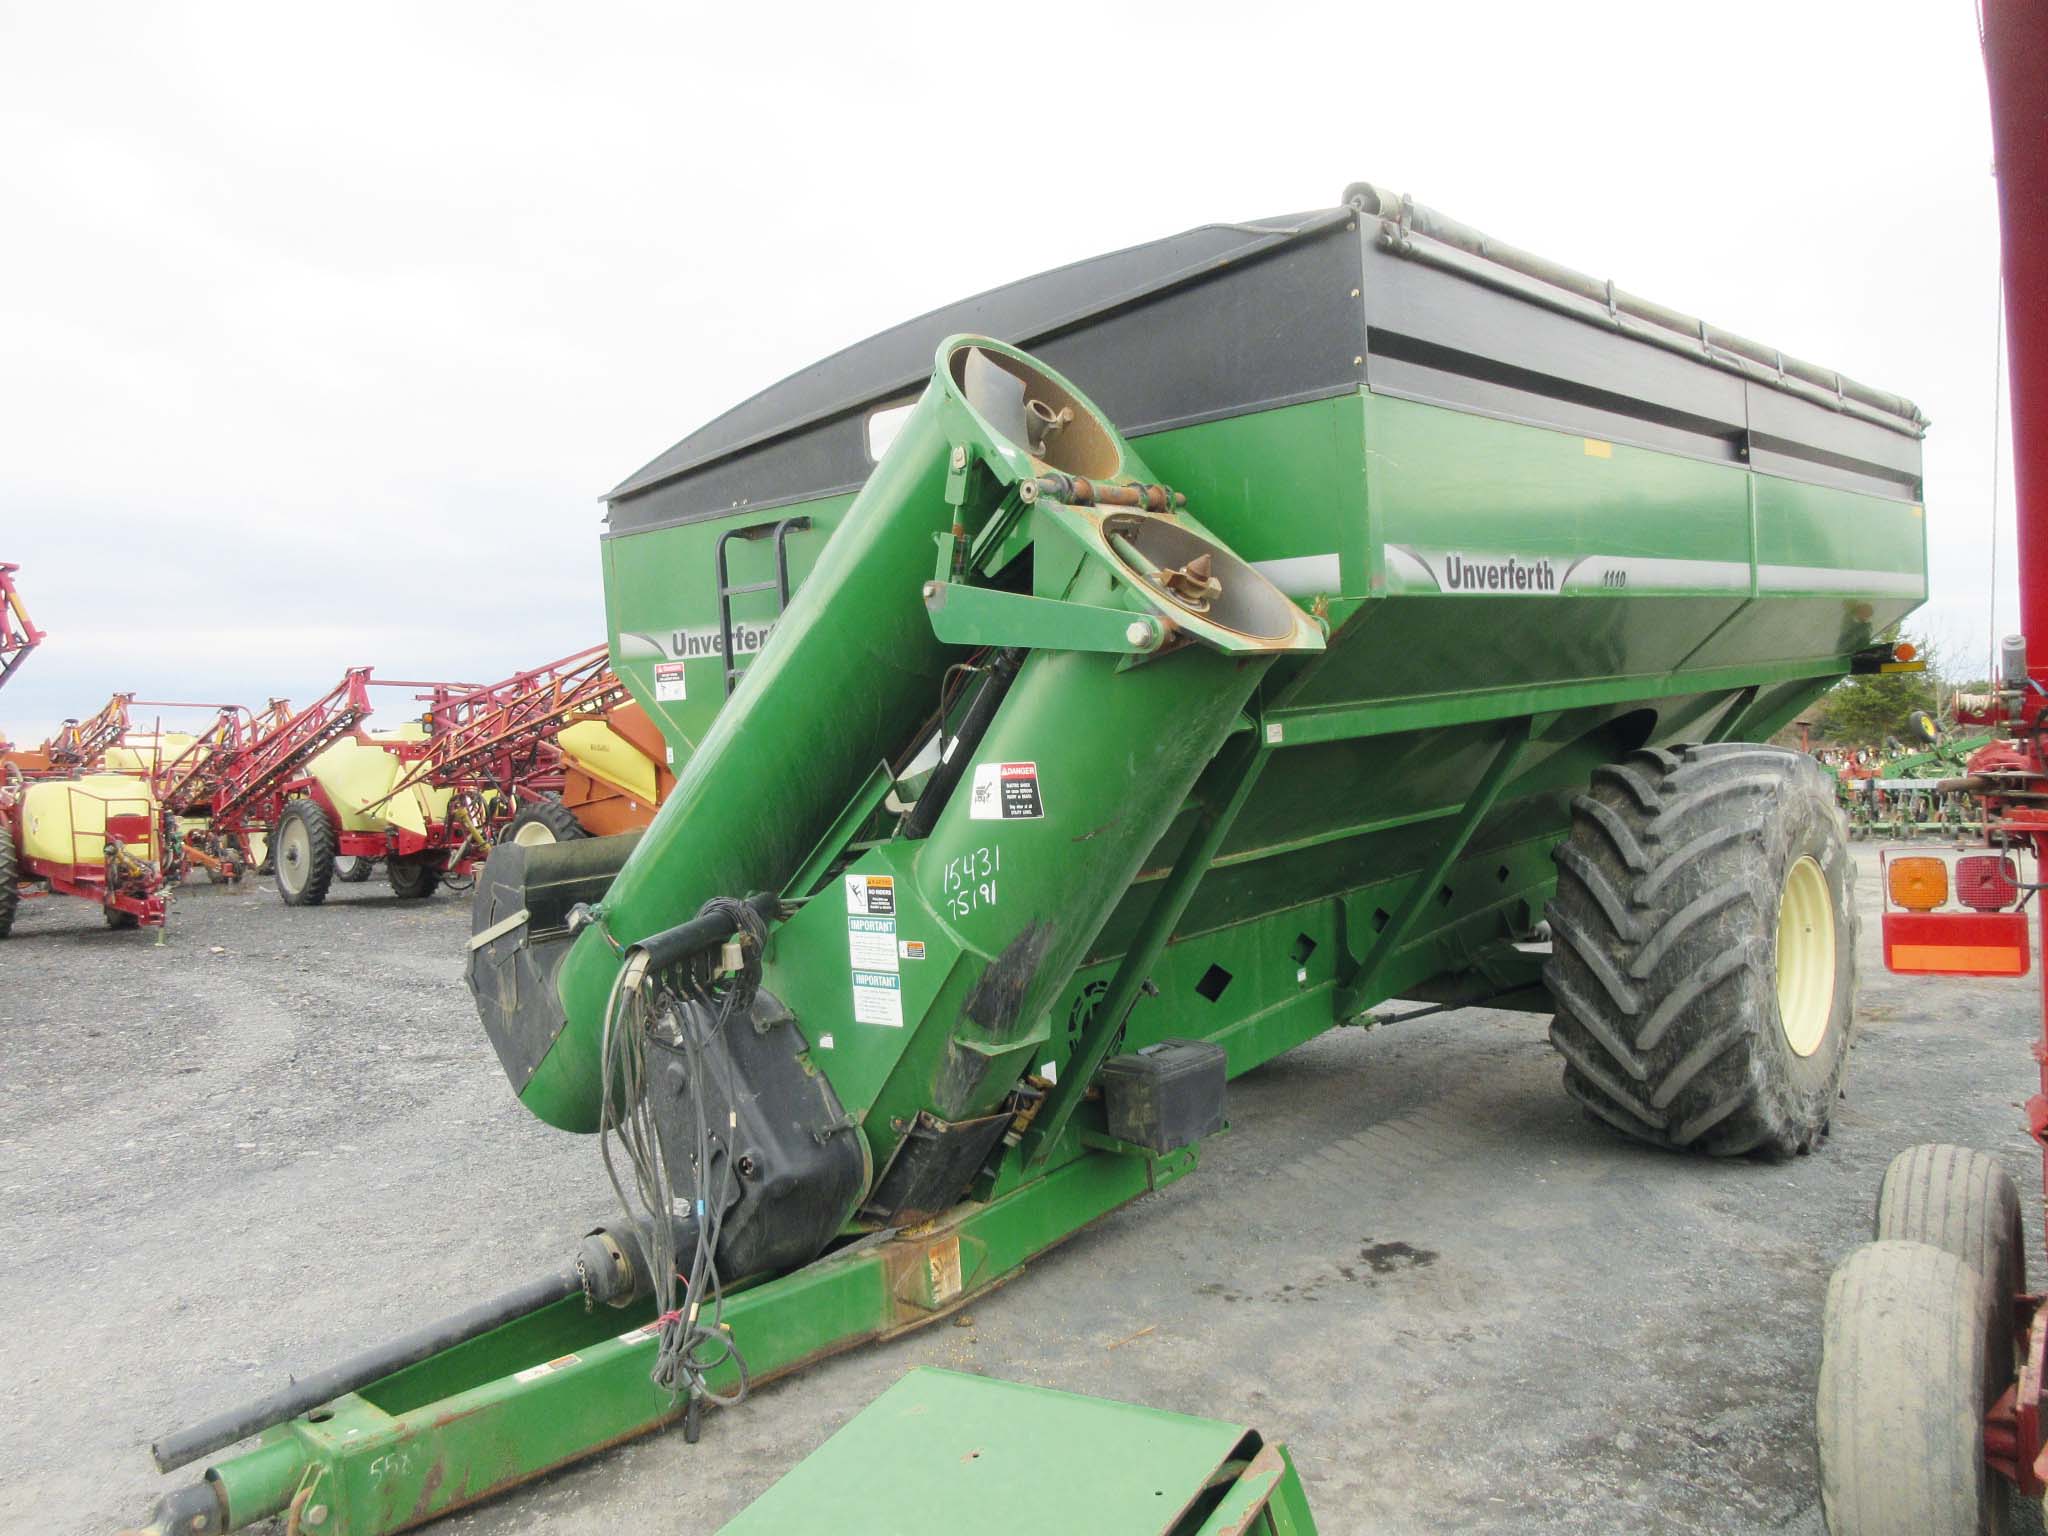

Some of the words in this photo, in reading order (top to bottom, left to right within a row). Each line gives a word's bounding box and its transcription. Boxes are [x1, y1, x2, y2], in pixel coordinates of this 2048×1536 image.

[1446, 556, 1555, 590] Unverferth
[1603, 570, 1627, 588] 1110
[672, 623, 776, 657] Unvefer
[1007, 766, 1035, 776] DANGER
[943, 844, 1000, 893] 15431
[850, 919, 894, 934] IMPORTANT
[855, 973, 897, 988] IMPORTANT
